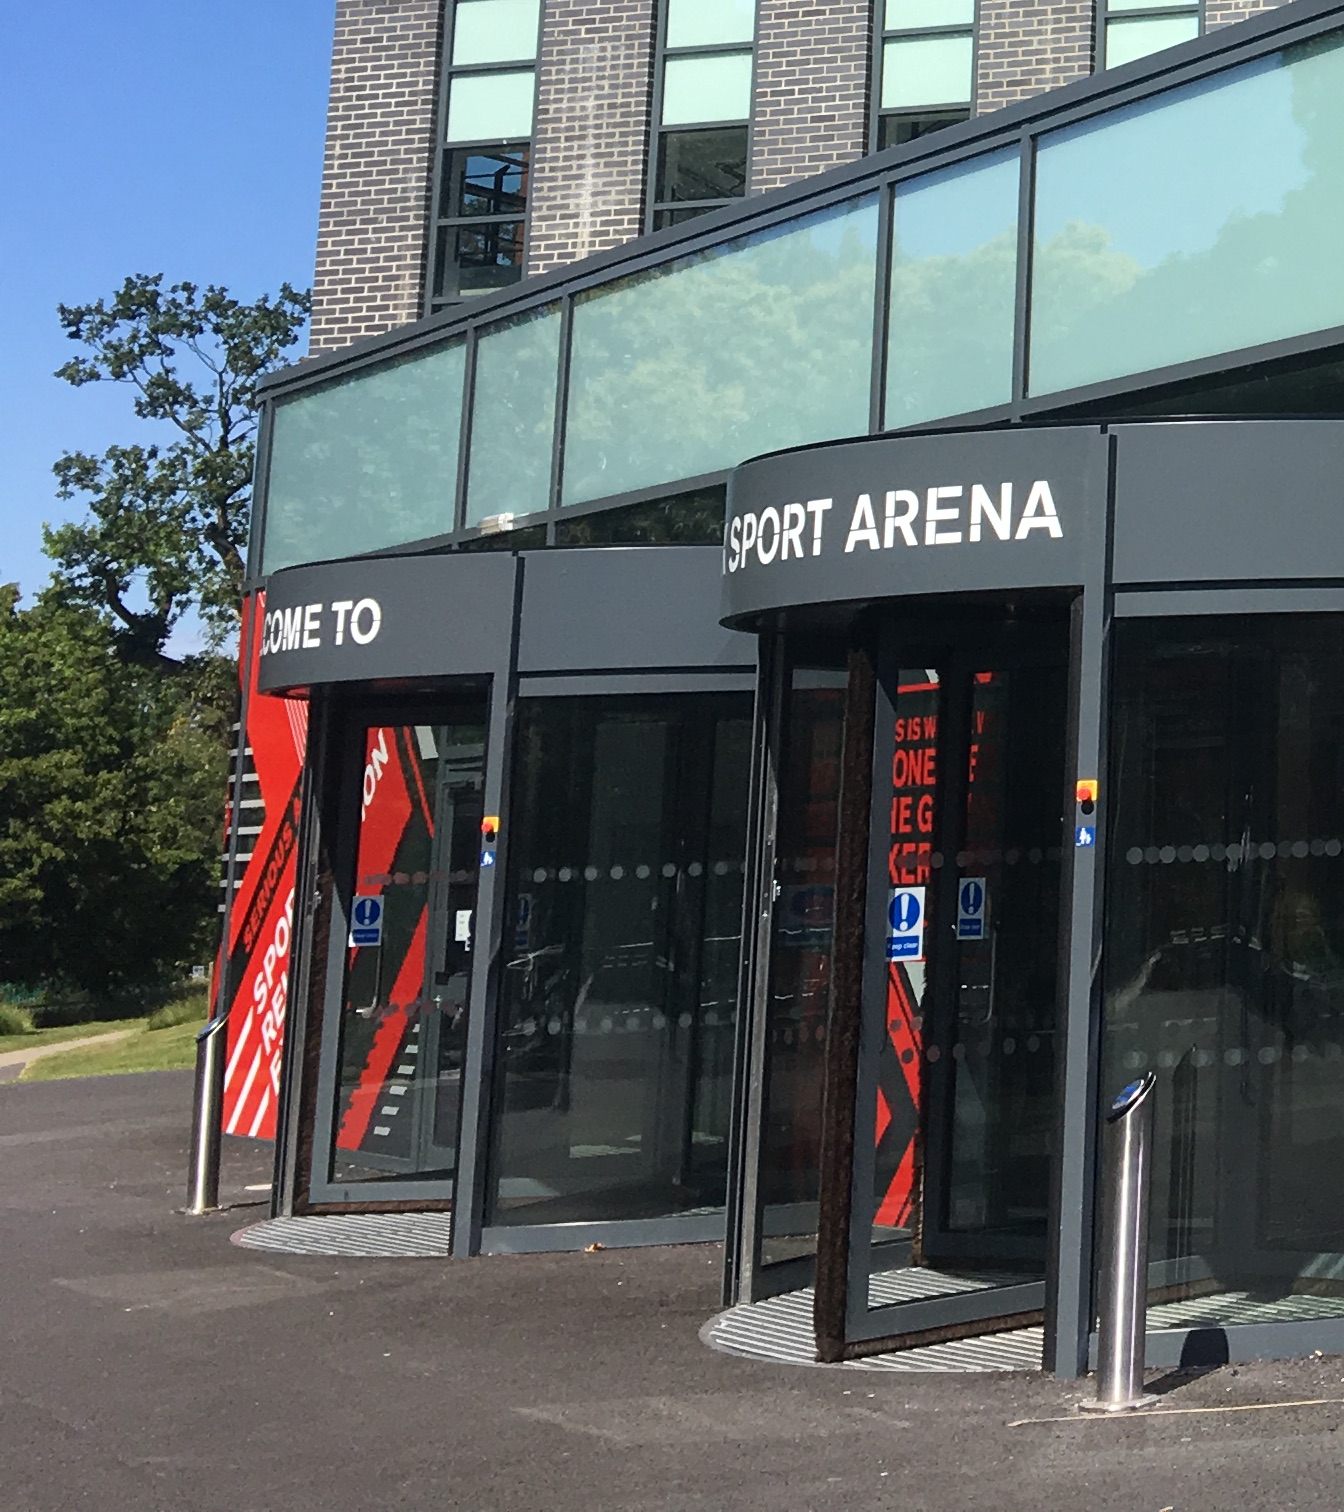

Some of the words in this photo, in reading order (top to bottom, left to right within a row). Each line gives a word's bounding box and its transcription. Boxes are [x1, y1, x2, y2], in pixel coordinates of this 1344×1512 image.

[728, 498, 833, 573] SPORT
[844, 480, 1064, 554] ARENA
[260, 606, 323, 657] COME
[331, 598, 382, 645] TO
